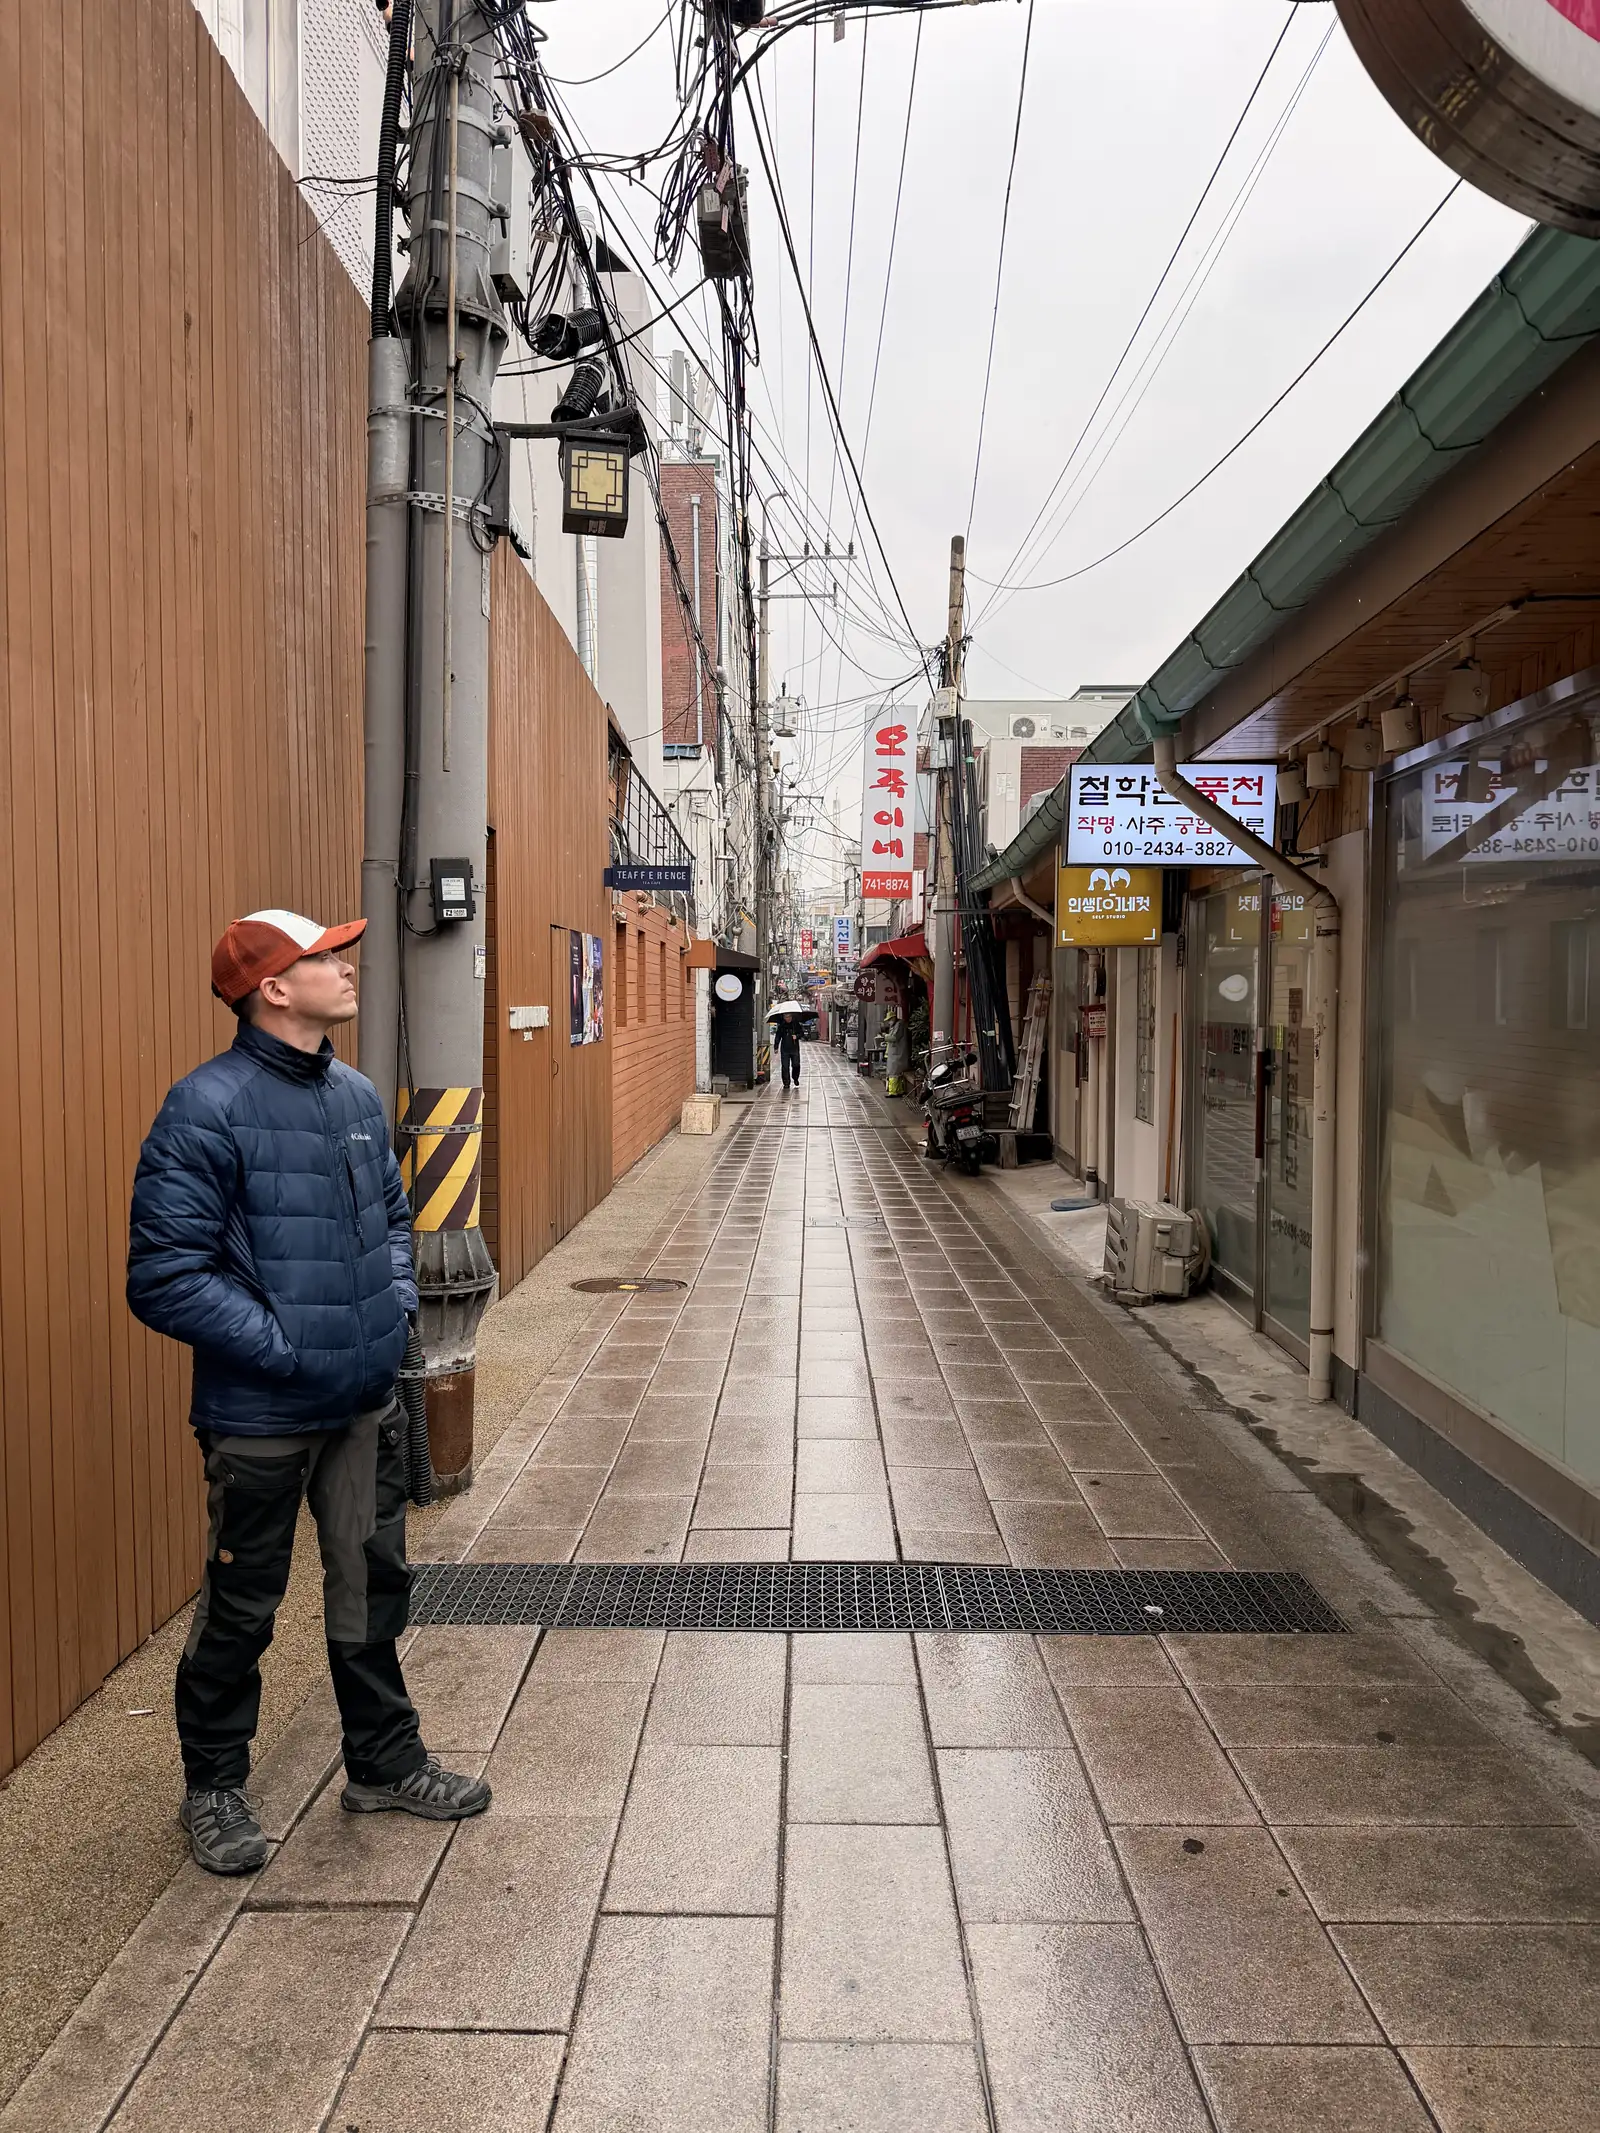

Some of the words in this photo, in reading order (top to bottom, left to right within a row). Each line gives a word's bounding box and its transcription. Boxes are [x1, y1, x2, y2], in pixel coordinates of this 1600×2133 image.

[869, 724, 909, 858] 오죽이네
[1194, 776, 1264, 806] 풍천
[1103, 841, 1235, 856] 010-2434-3827
[865, 878, 910, 891] 741-8874
